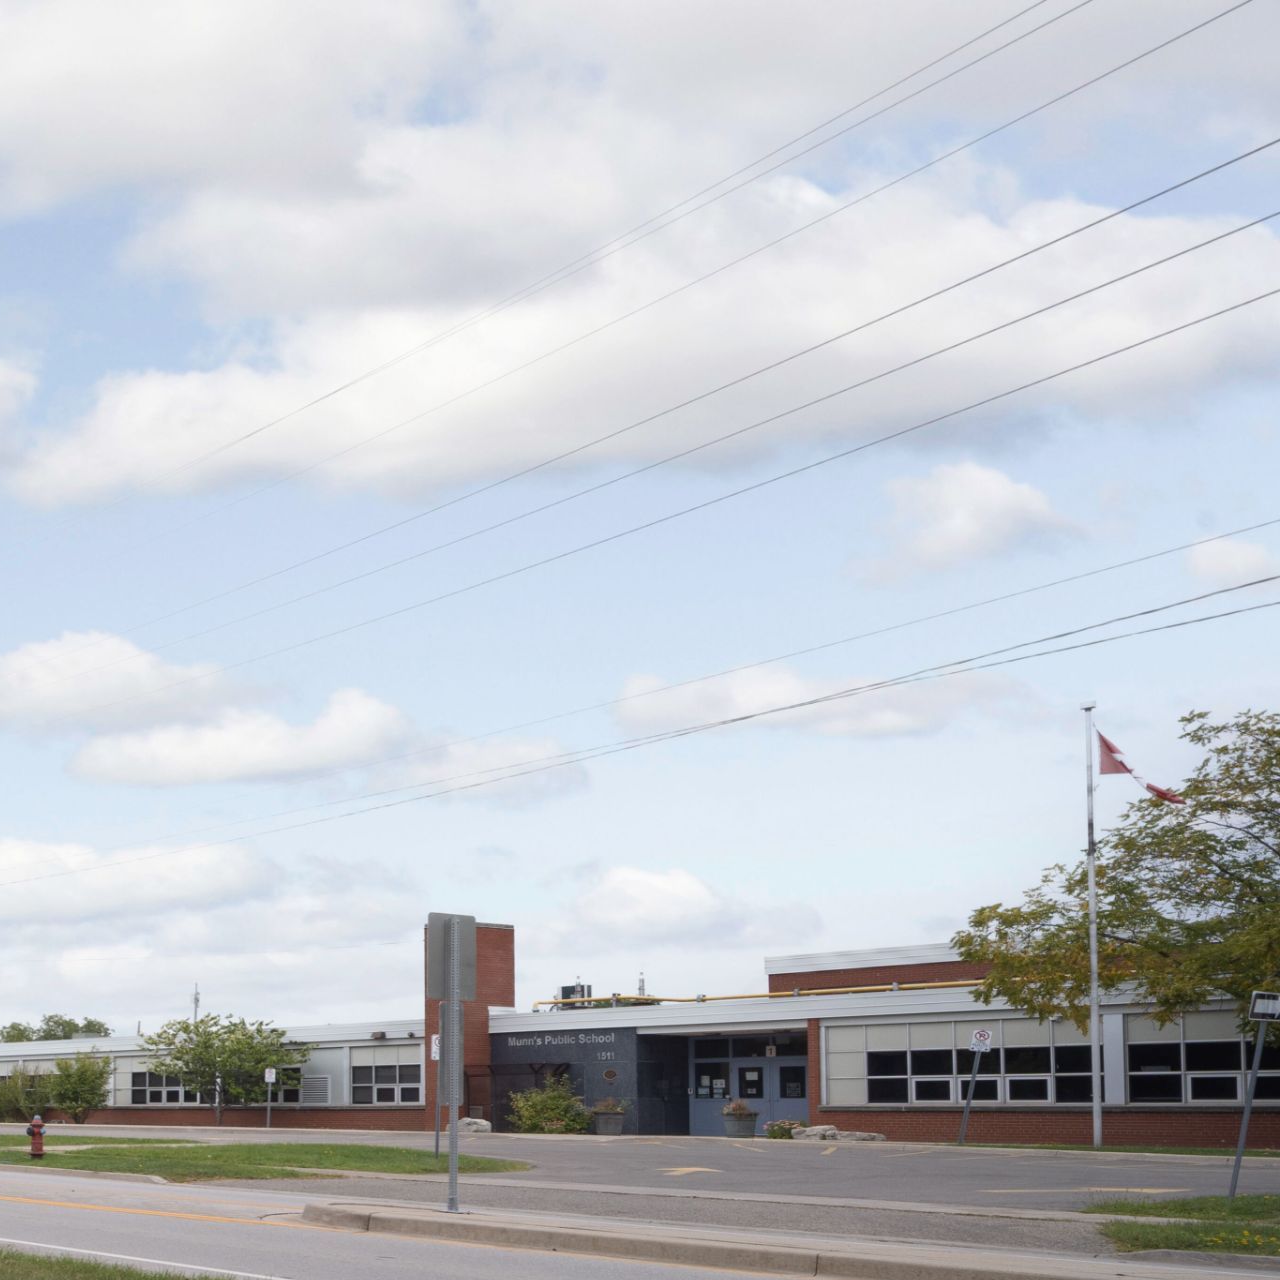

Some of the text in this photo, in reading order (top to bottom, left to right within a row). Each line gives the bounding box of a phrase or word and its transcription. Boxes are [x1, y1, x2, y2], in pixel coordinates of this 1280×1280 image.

[508, 1032, 615, 1047] Munn's Public School
